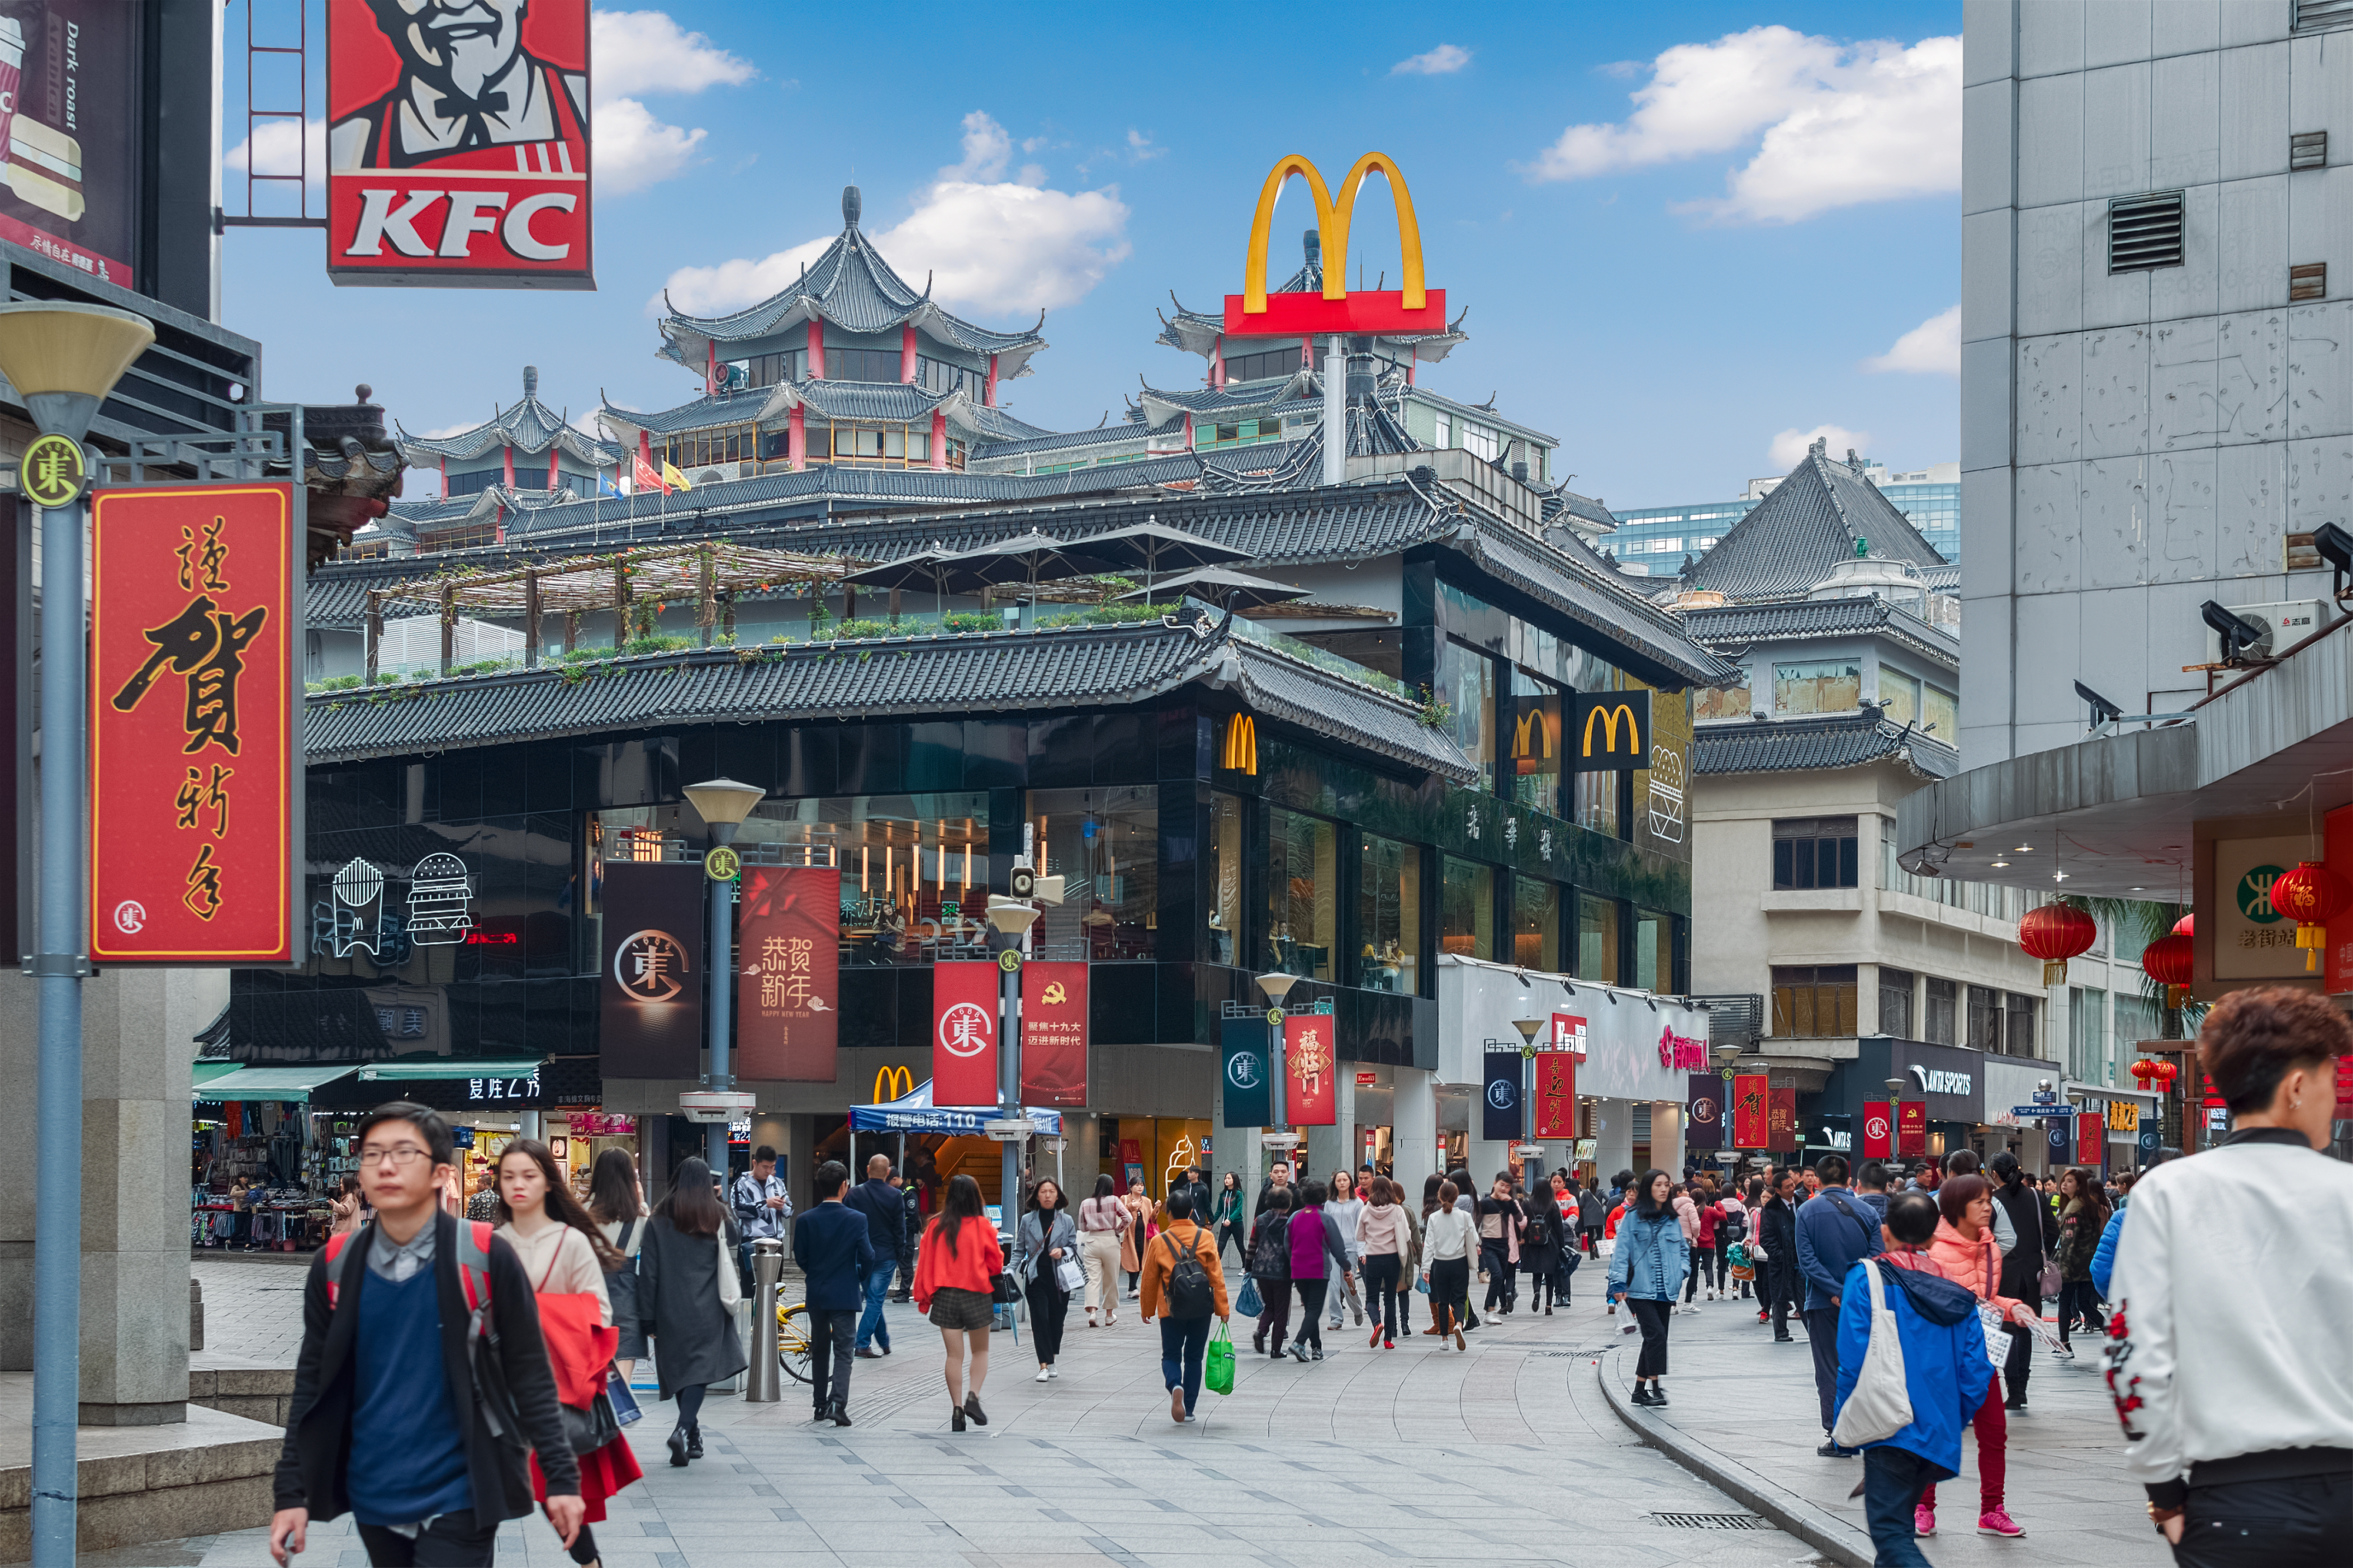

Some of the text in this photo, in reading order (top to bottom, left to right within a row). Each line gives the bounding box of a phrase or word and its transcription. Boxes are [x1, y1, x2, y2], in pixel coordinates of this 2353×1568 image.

[66, 20, 79, 132] Dark roast
[346, 189, 578, 261] KFC
[29, 235, 71, 263] 尽情自在
[36, 451, 72, 493] 東
[2291, 618, 2310, 626] 志高
[715, 855, 732, 874] 東
[2238, 929, 2296, 948] 老街站
[762, 936, 813, 972] 恭贺
[1004, 953, 1018, 969] 東
[631, 946, 675, 990] 東
[762, 973, 811, 1008] 新年
[952, 1007, 981, 1018] 1688
[951, 1014, 981, 1047] 東
[1028, 1022, 1081, 1032] 聚焦十九大
[1028, 1036, 1081, 1046] 迈进新时代
[1236, 1059, 1256, 1082] 東
[1299, 1029, 1320, 1095] 福临门
[1928, 1069, 1971, 1096] ANTA SPORTS
[1495, 1086, 1511, 1104] 東
[886, 1113, 976, 1127] 报警电话:110
[1698, 1103, 1712, 1119] 東
[1771, 1109, 1787, 1119] 恭贺
[1771, 1120, 1787, 1131] 新年
[1871, 1122, 1882, 1136] 東
[1833, 1131, 1846, 1147] ANTA
